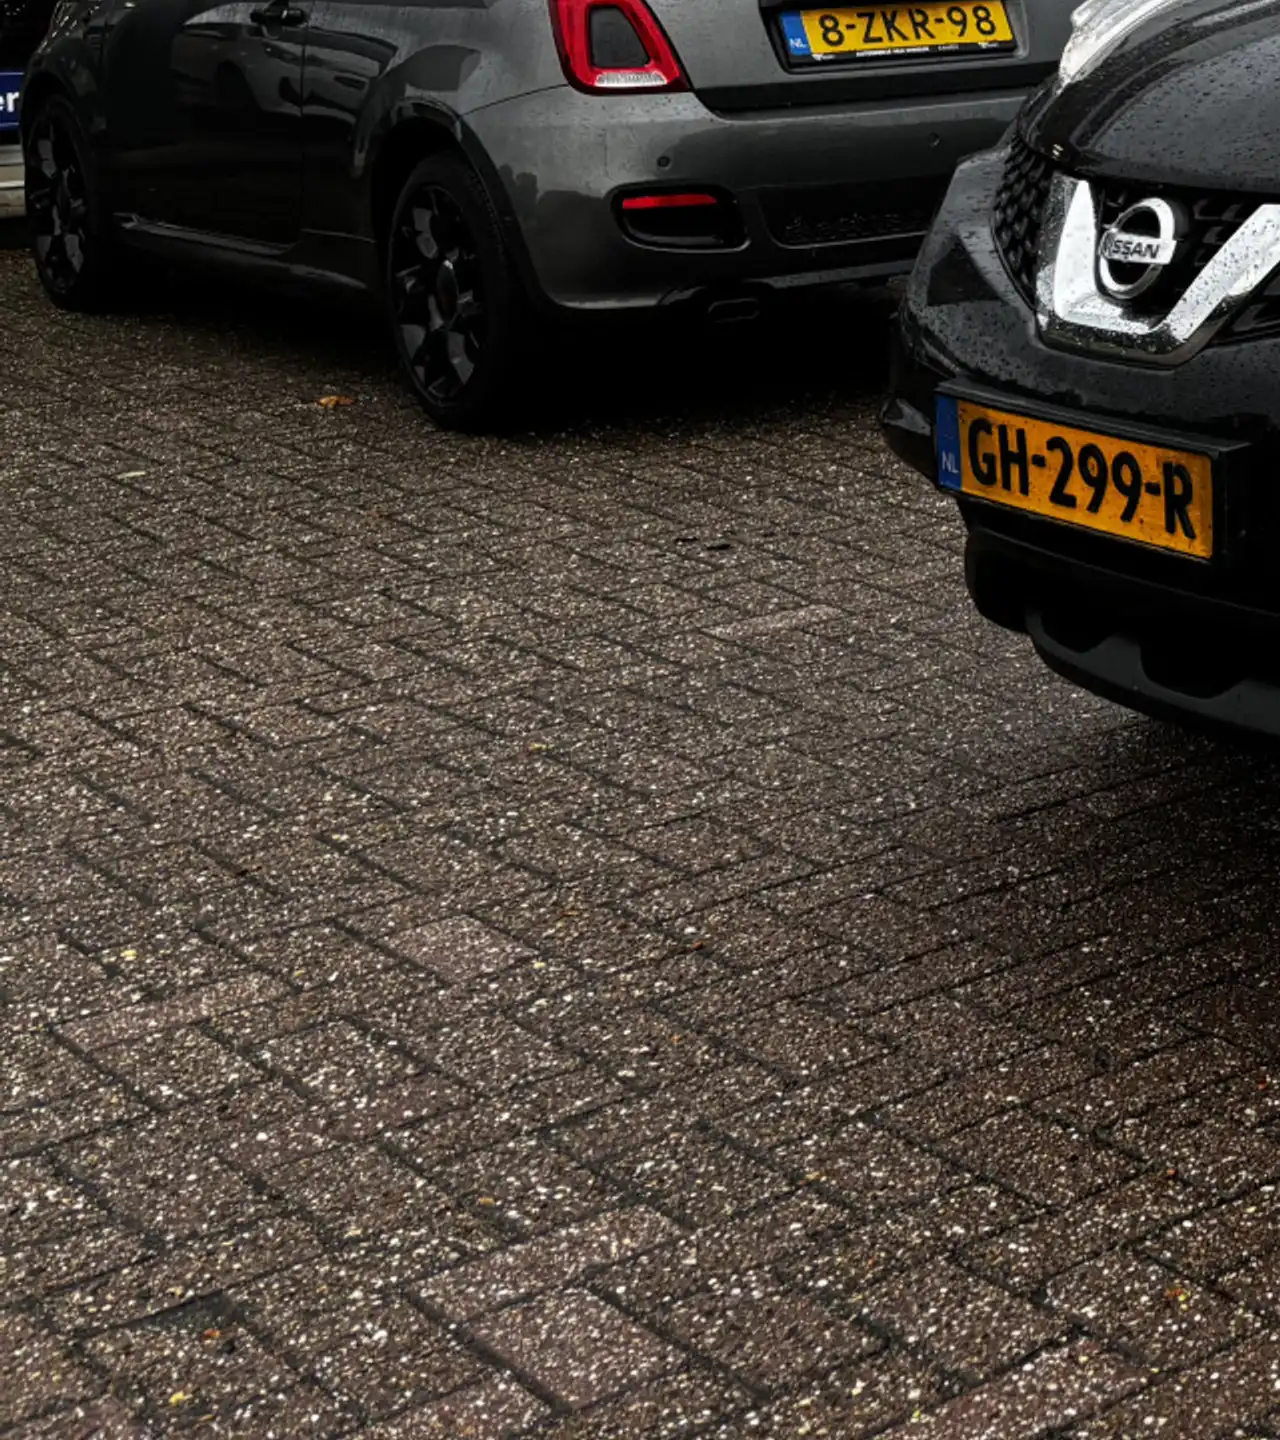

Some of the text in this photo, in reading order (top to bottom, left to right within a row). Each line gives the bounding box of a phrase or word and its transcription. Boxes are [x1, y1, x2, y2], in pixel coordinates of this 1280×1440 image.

[818, 6, 997, 46] 8-ZKR-98
[941, 417, 1197, 540] NL GH-299-R
